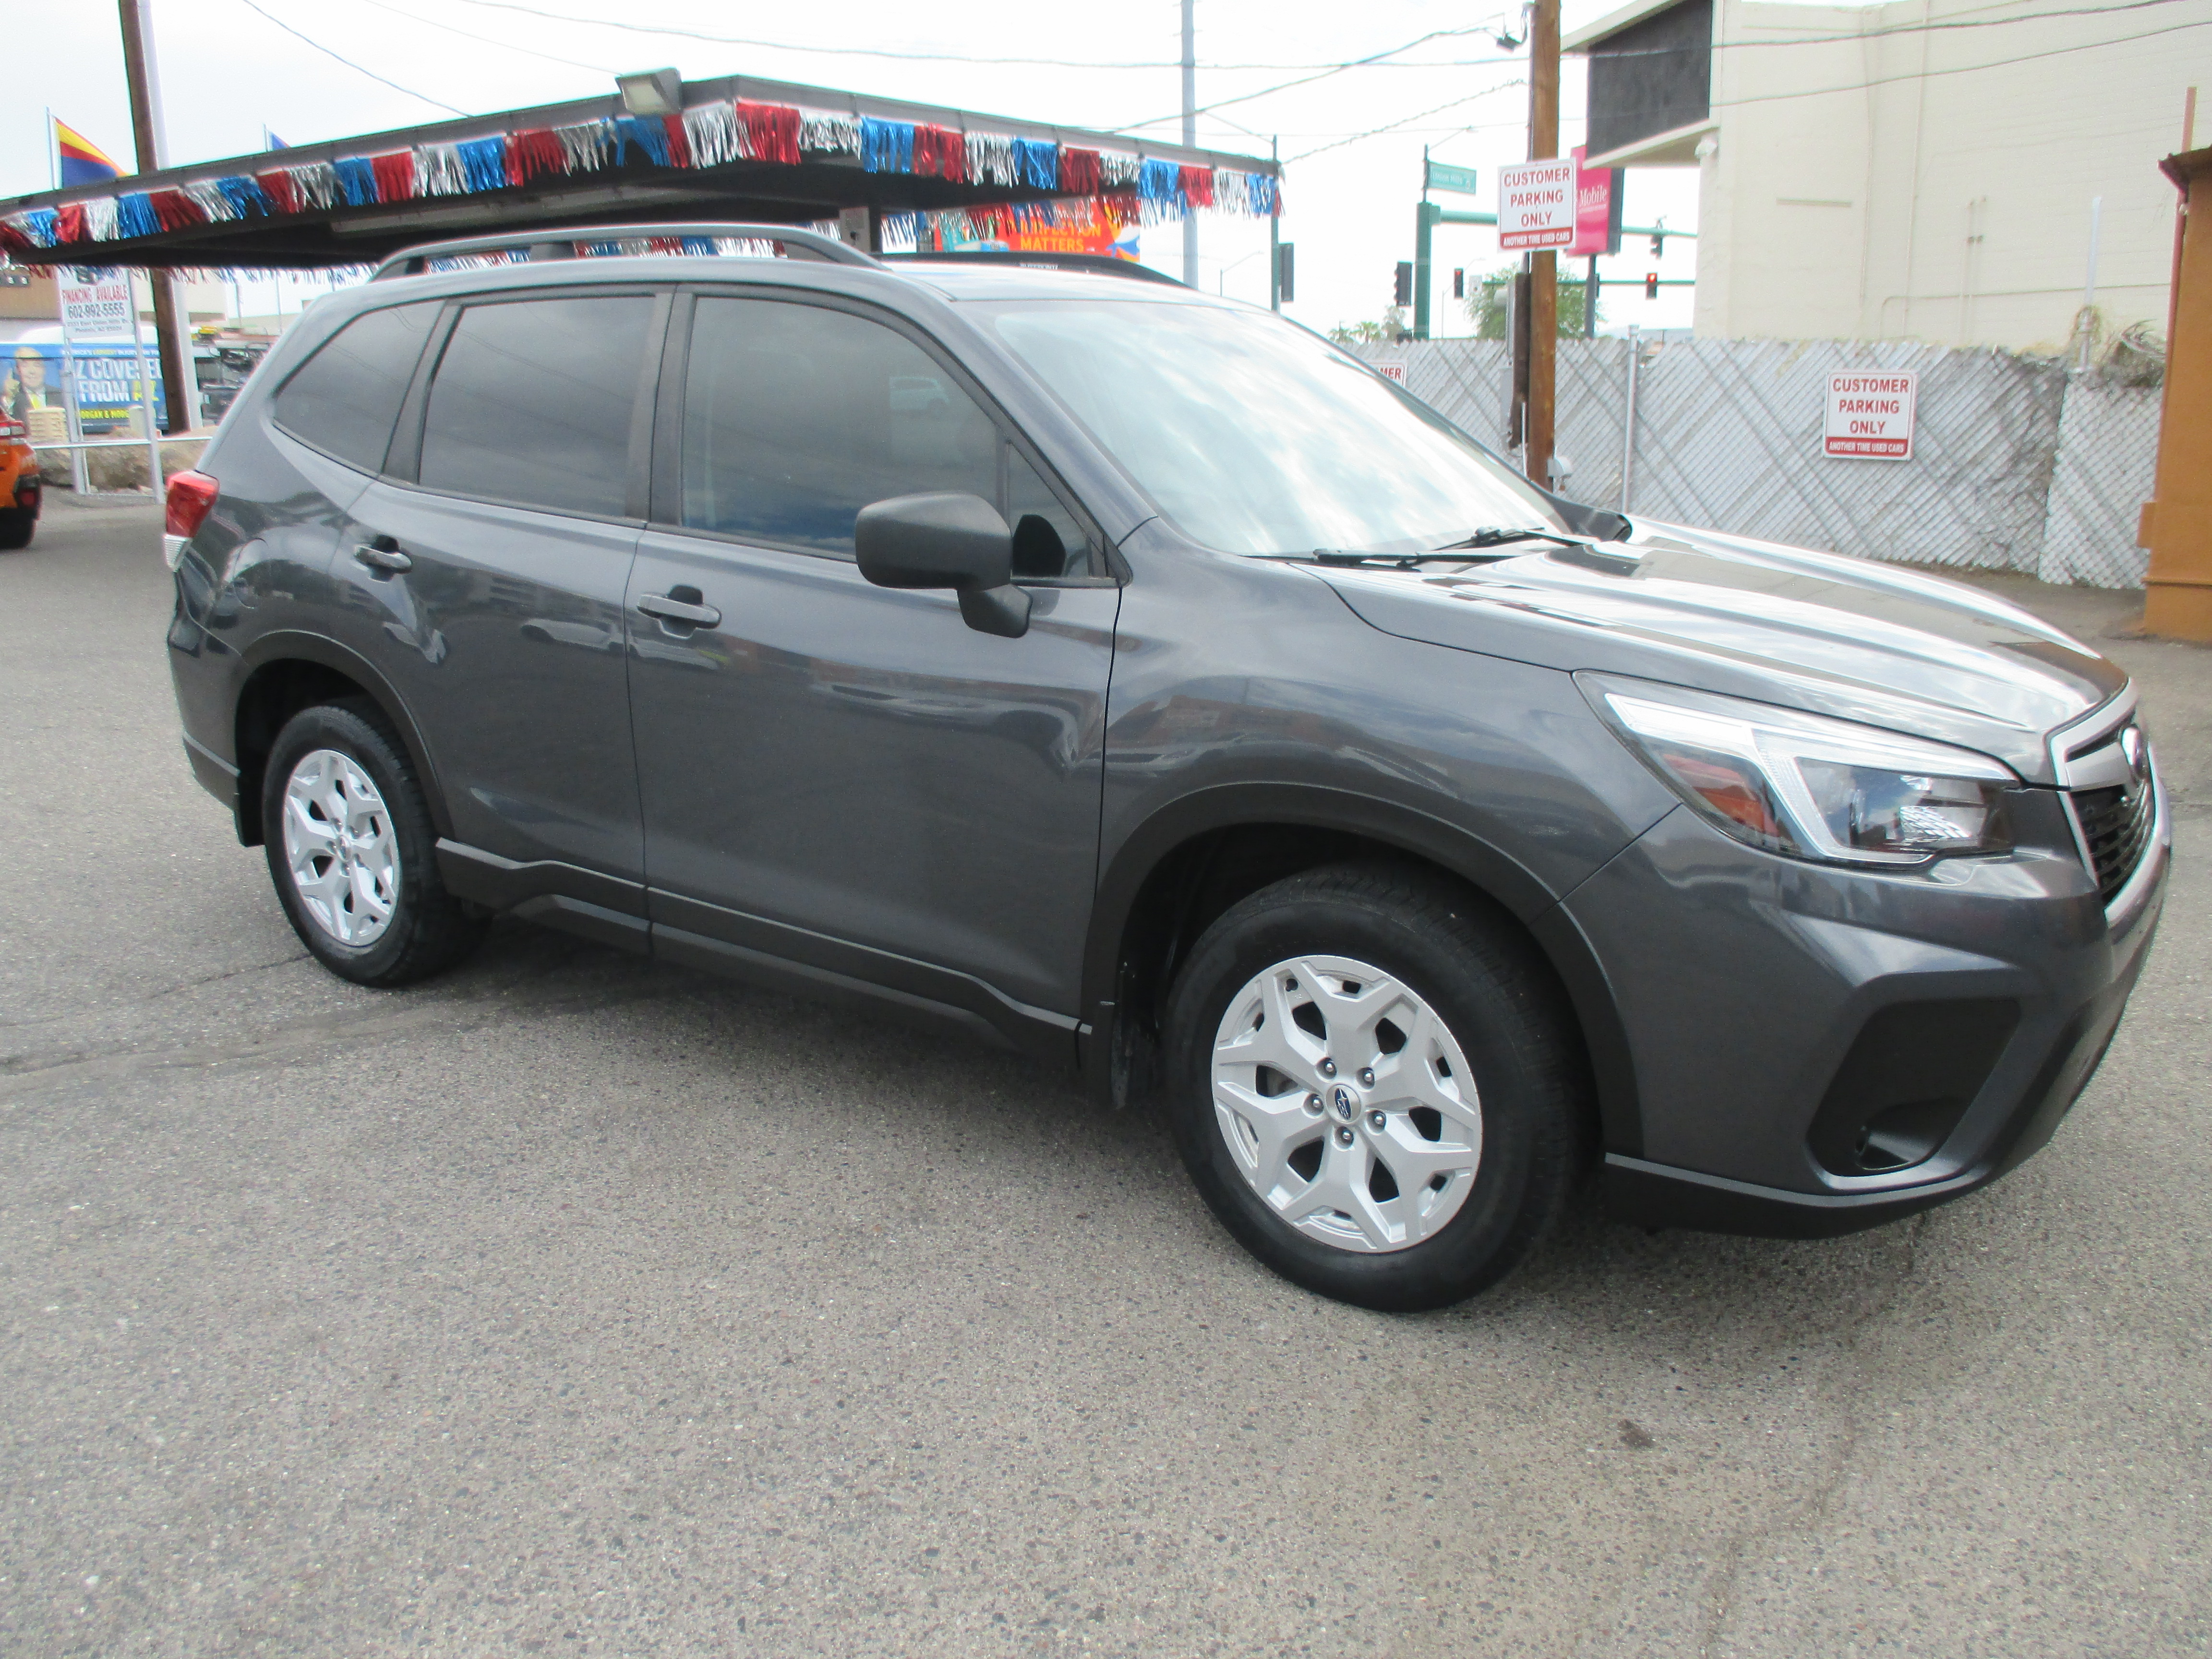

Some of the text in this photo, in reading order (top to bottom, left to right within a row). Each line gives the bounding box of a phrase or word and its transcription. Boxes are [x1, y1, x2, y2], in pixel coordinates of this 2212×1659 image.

[1503, 168, 1570, 187] CUSTOMER
[1510, 189, 1563, 207] PARKING
[1520, 211, 1552, 227] ONLY
[1021, 237, 1084, 252] MATTERS
[1503, 231, 1570, 247] ANOTHER TIME USED CARS
[62, 284, 129, 305] FINANCING AVAILABLE
[68, 302, 126, 319] 602-992-5555
[78, 379, 131, 402] FROM
[1832, 378, 1909, 393] CUSTOMER
[1838, 399, 1899, 414] PARKING
[1849, 420, 1886, 434] ONLY
[1828, 441, 1904, 453] ANOTHER TIME USED CARS
